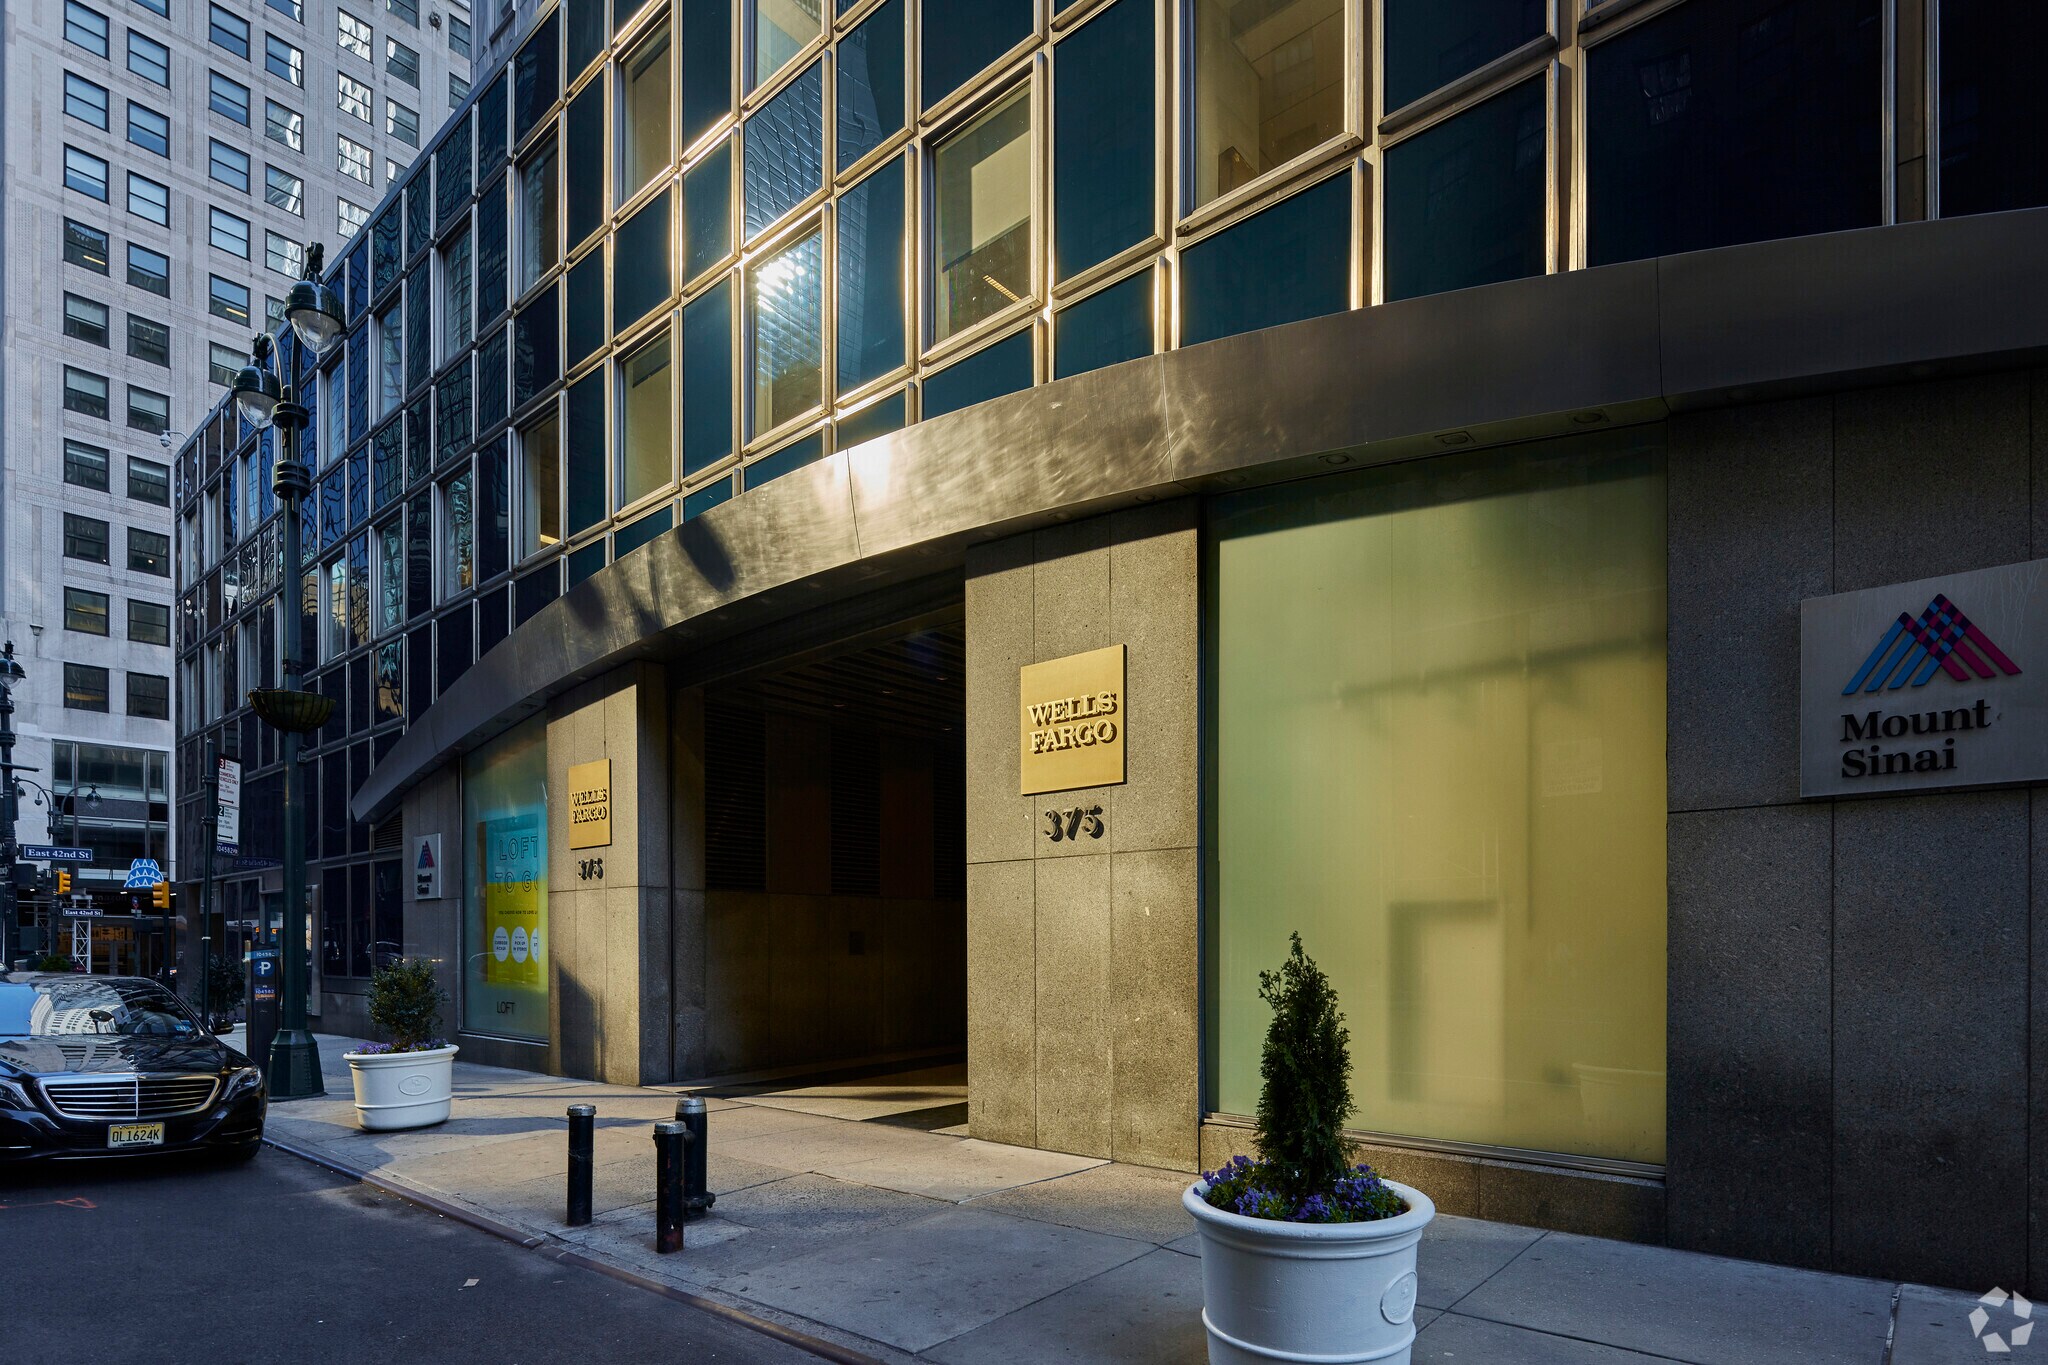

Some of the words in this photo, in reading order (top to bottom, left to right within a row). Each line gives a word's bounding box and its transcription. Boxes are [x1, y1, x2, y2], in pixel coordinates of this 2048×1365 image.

[1027, 690, 1117, 726] WELLS
[1840, 699, 1991, 742] Mount
[1029, 719, 1117, 753] FARGO
[1841, 738, 1958, 779] Sinai
[570, 787, 607, 806] WELLS
[571, 806, 607, 824] FARGO
[1043, 805, 1104, 842] 375
[28, 848, 50, 857] East
[52, 850, 76, 859] 42nd
[78, 851, 89, 859] St
[499, 835, 538, 861] LOFT
[578, 858, 604, 880] 375
[495, 871, 515, 893] TO
[261, 961, 271, 975] P
[496, 1001, 515, 1015] LOFT
